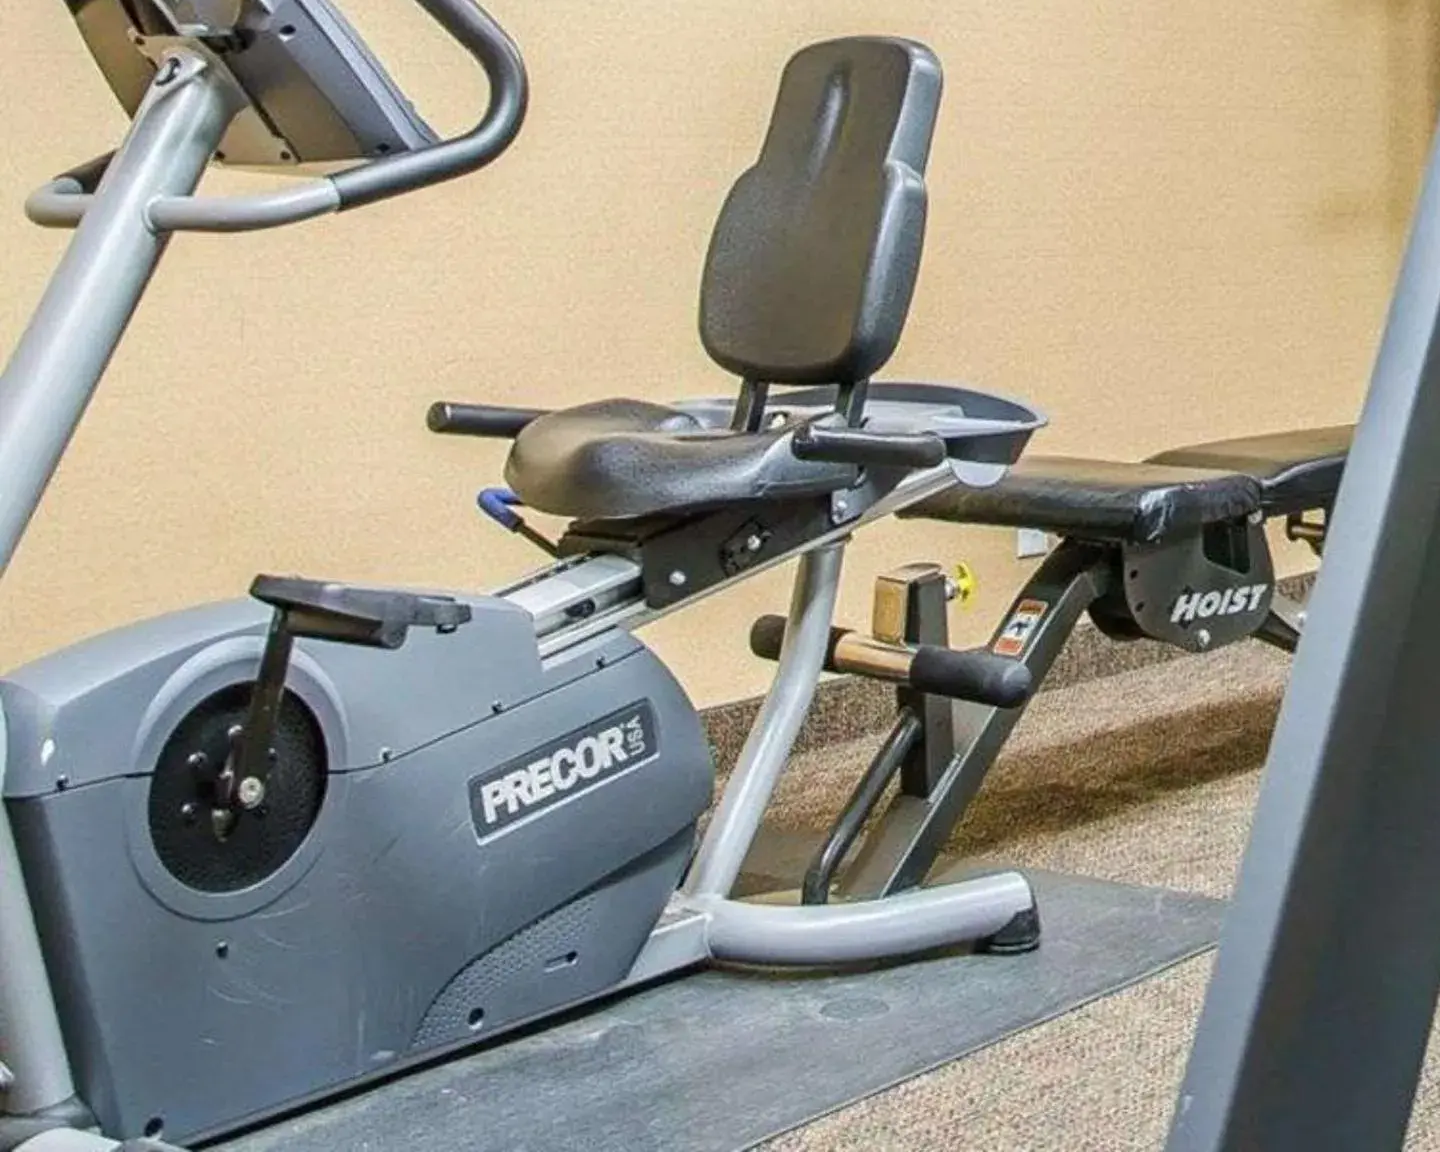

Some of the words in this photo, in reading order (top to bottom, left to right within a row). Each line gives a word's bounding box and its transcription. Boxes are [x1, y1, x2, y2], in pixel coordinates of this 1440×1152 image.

[1170, 584, 1268, 622] HOIST
[480, 726, 628, 824] PRECOR
[626, 715, 646, 756] USA
